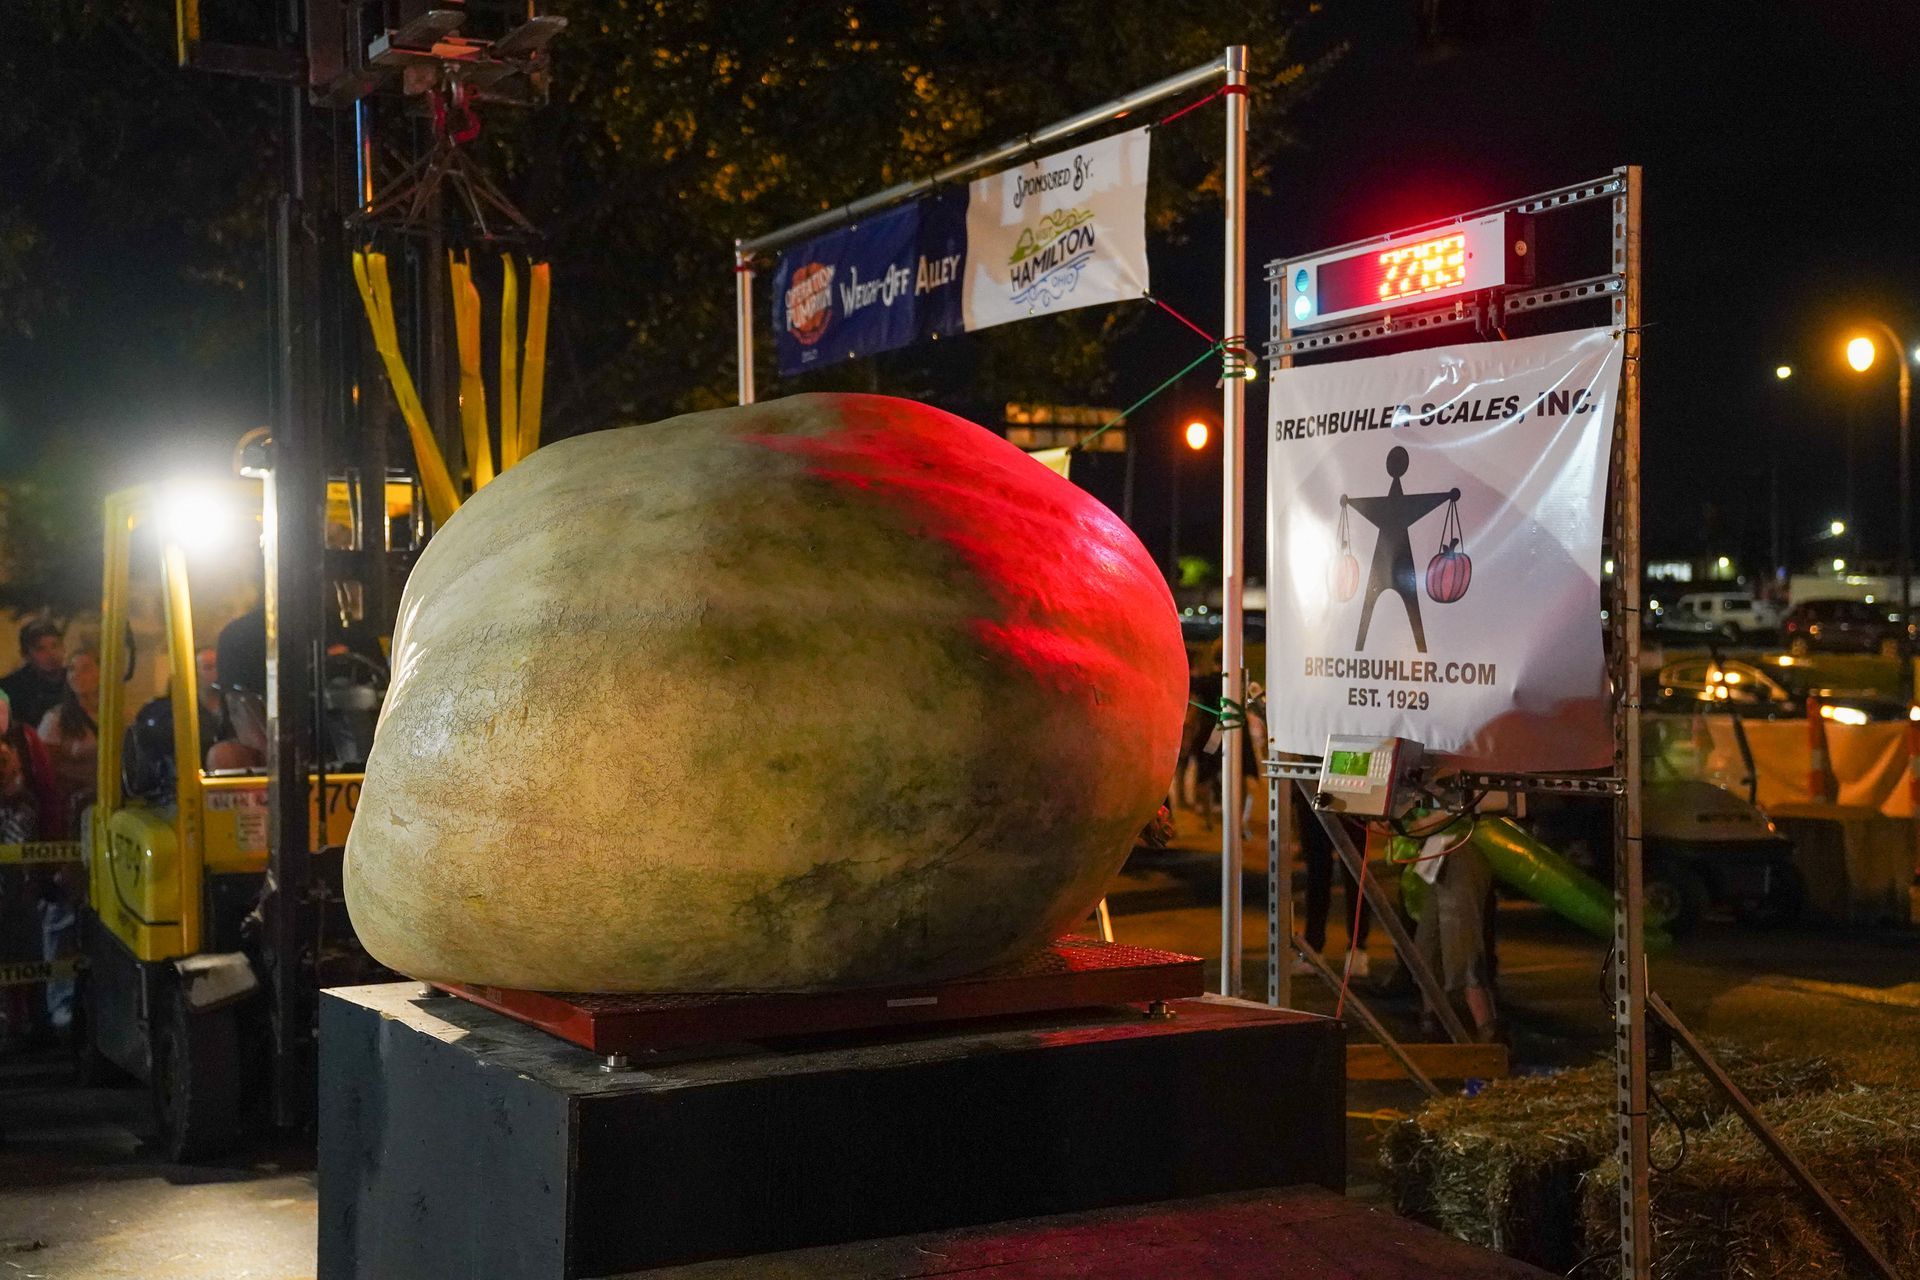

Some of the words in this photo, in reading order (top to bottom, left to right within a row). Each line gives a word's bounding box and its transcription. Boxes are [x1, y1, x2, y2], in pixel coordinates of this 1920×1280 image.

[1013, 167, 1071, 208] SPONSORED
[1010, 223, 1095, 292] HAMILTON
[1051, 272, 1075, 289] OHIO
[1275, 404, 1411, 442] BRECHBUHLER
[1419, 394, 1526, 427] SCALES,
[1536, 388, 1598, 417] INC.
[1304, 656, 1497, 686] BRECHBUHLER.COM
[1347, 687, 1381, 708] EST.
[1387, 688, 1430, 712] 1929
